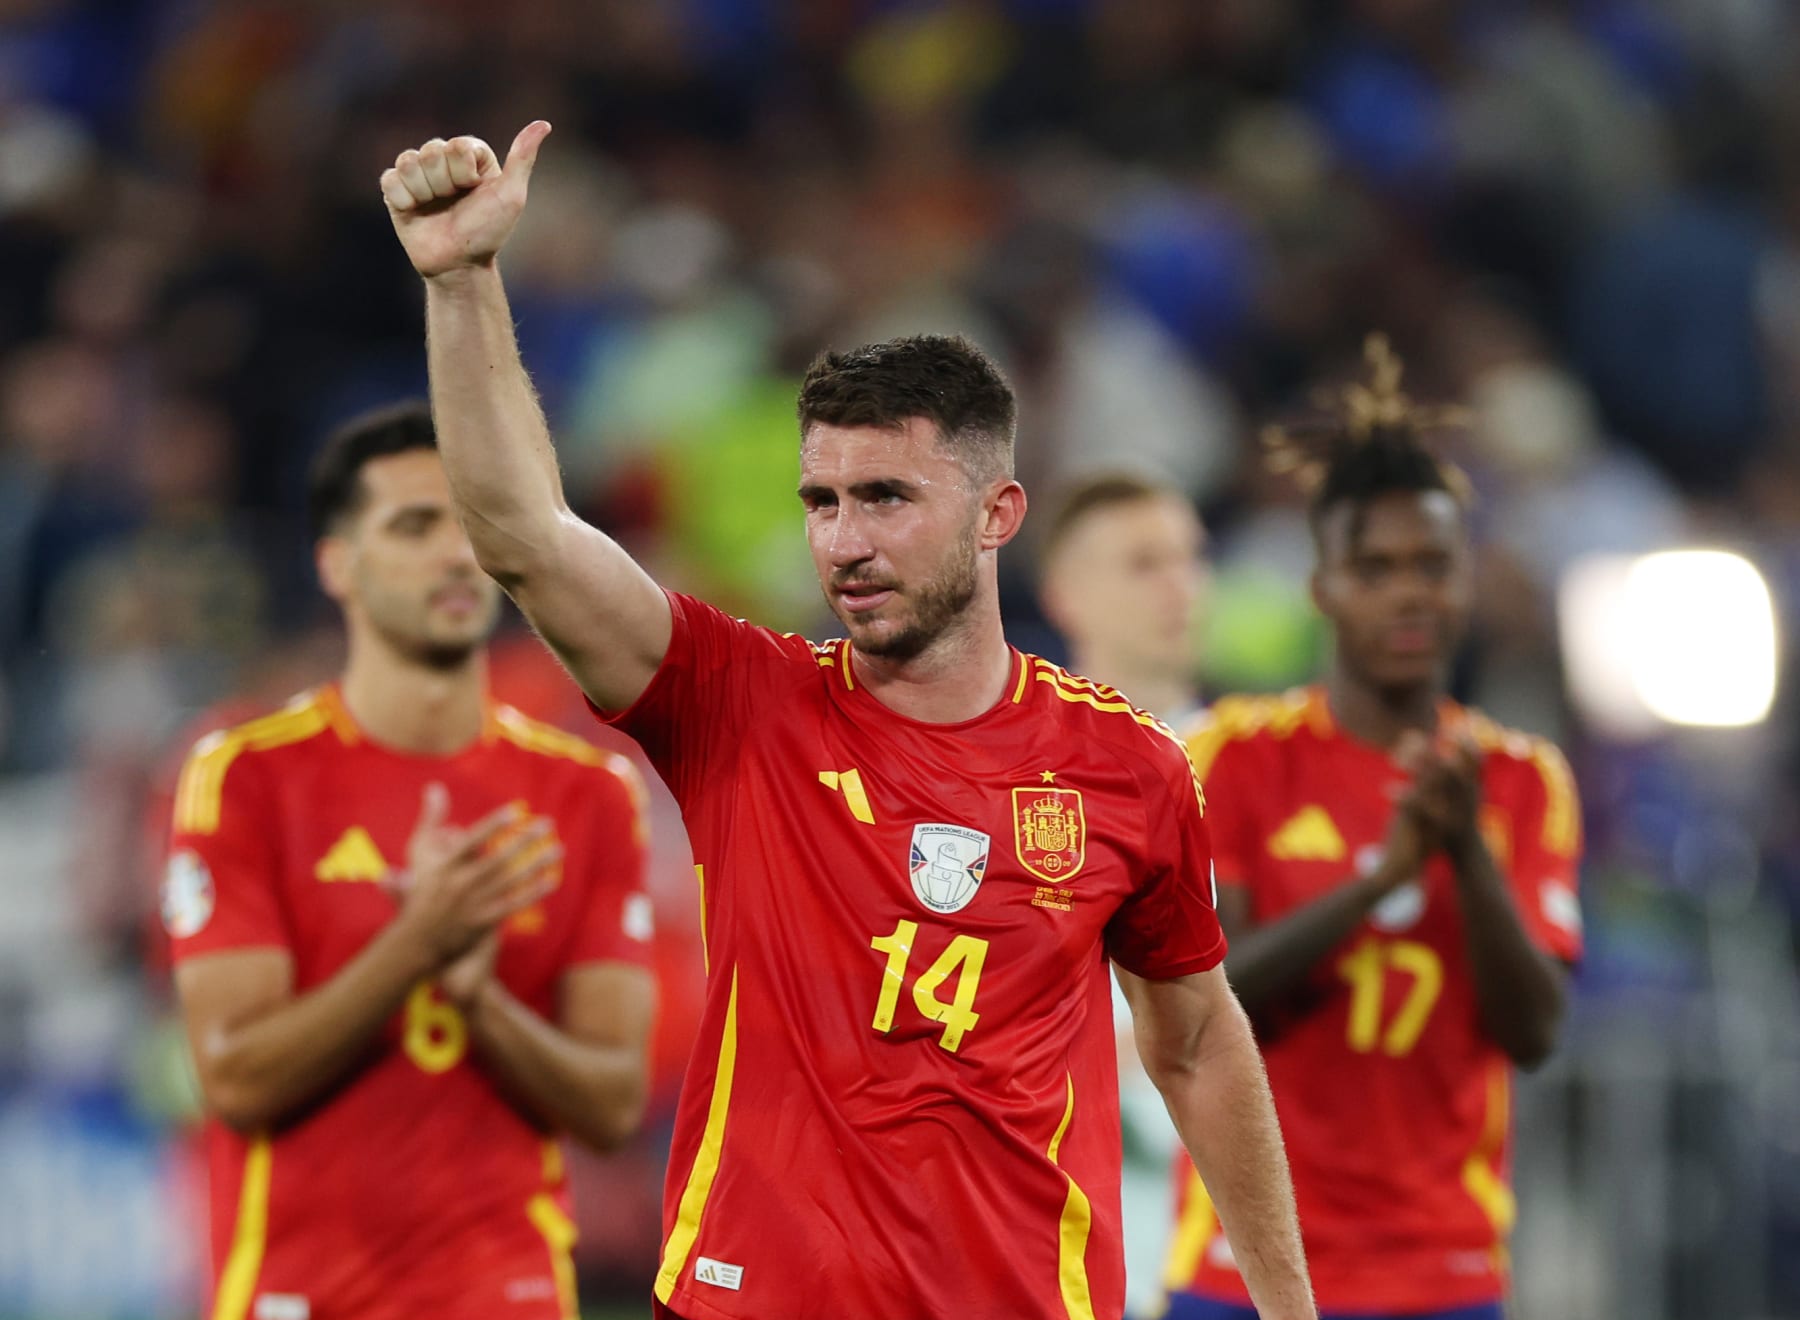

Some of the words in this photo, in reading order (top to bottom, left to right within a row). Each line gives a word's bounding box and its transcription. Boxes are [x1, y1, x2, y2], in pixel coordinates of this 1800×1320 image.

[403, 980, 468, 1073] 6
[870, 918, 990, 1053] 14
[1337, 938, 1444, 1057] 17
